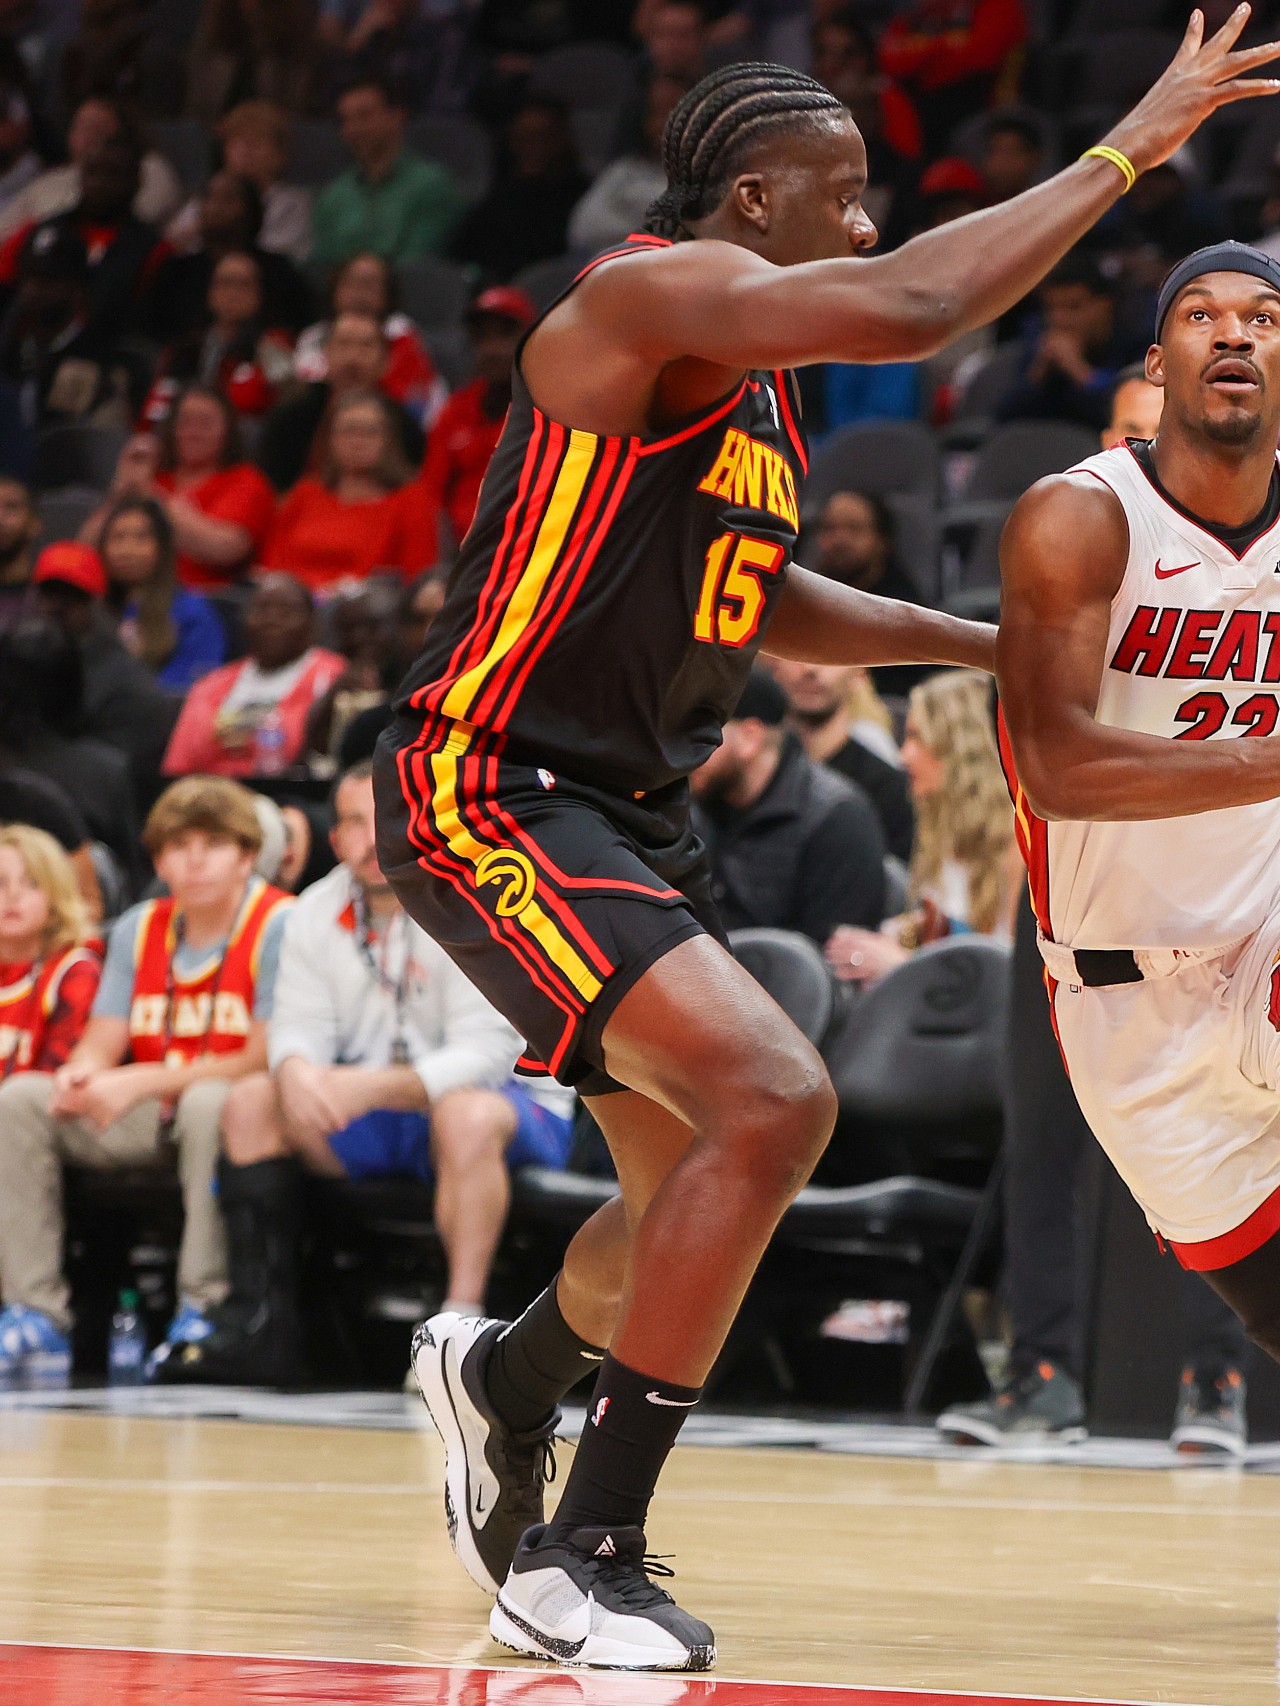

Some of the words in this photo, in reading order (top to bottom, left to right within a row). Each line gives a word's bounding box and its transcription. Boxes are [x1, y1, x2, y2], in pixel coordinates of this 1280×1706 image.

[697, 426, 799, 535] HWKS
[694, 531, 785, 648] 15
[1173, 691, 1280, 740] 22
